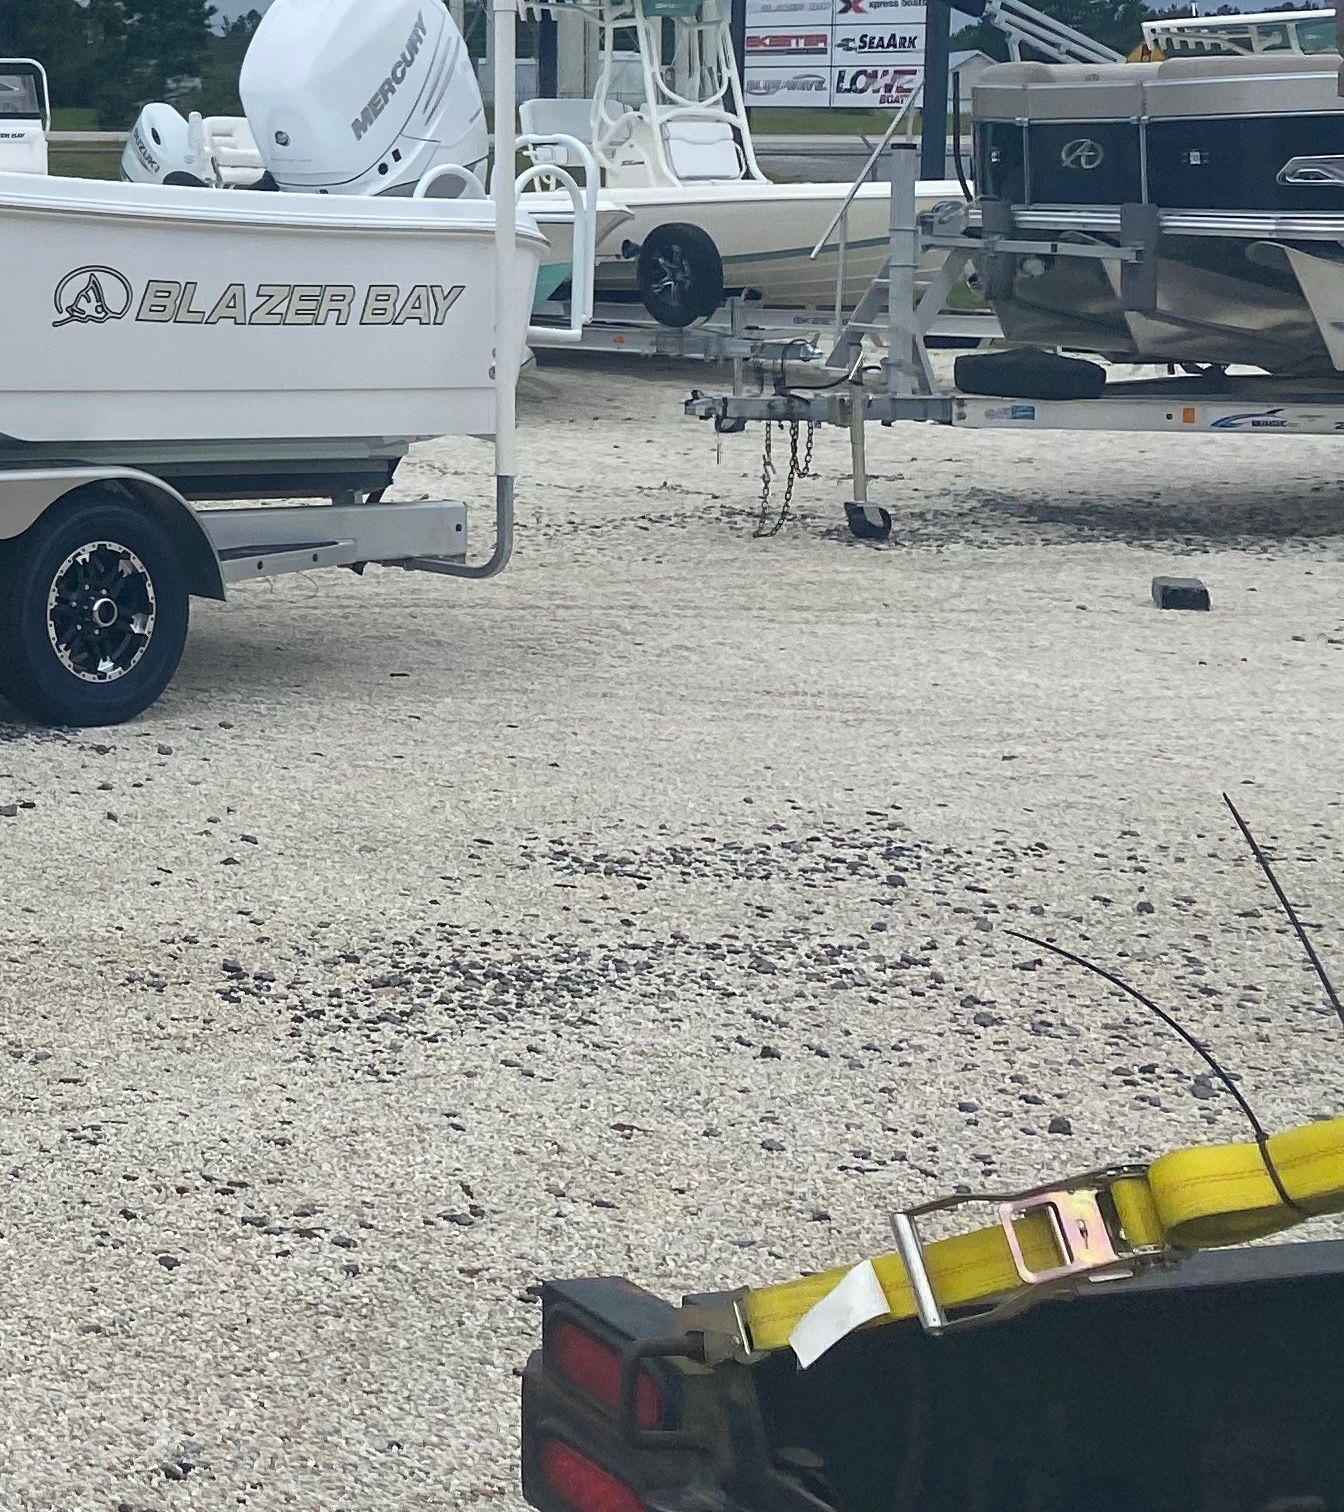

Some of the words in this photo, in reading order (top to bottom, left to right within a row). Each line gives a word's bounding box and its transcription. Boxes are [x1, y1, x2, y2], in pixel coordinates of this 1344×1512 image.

[350, 8, 427, 141] MERCURY
[835, 69, 918, 95] LOWE
[135, 280, 355, 325] BLAZER
[359, 284, 466, 325] BAY
